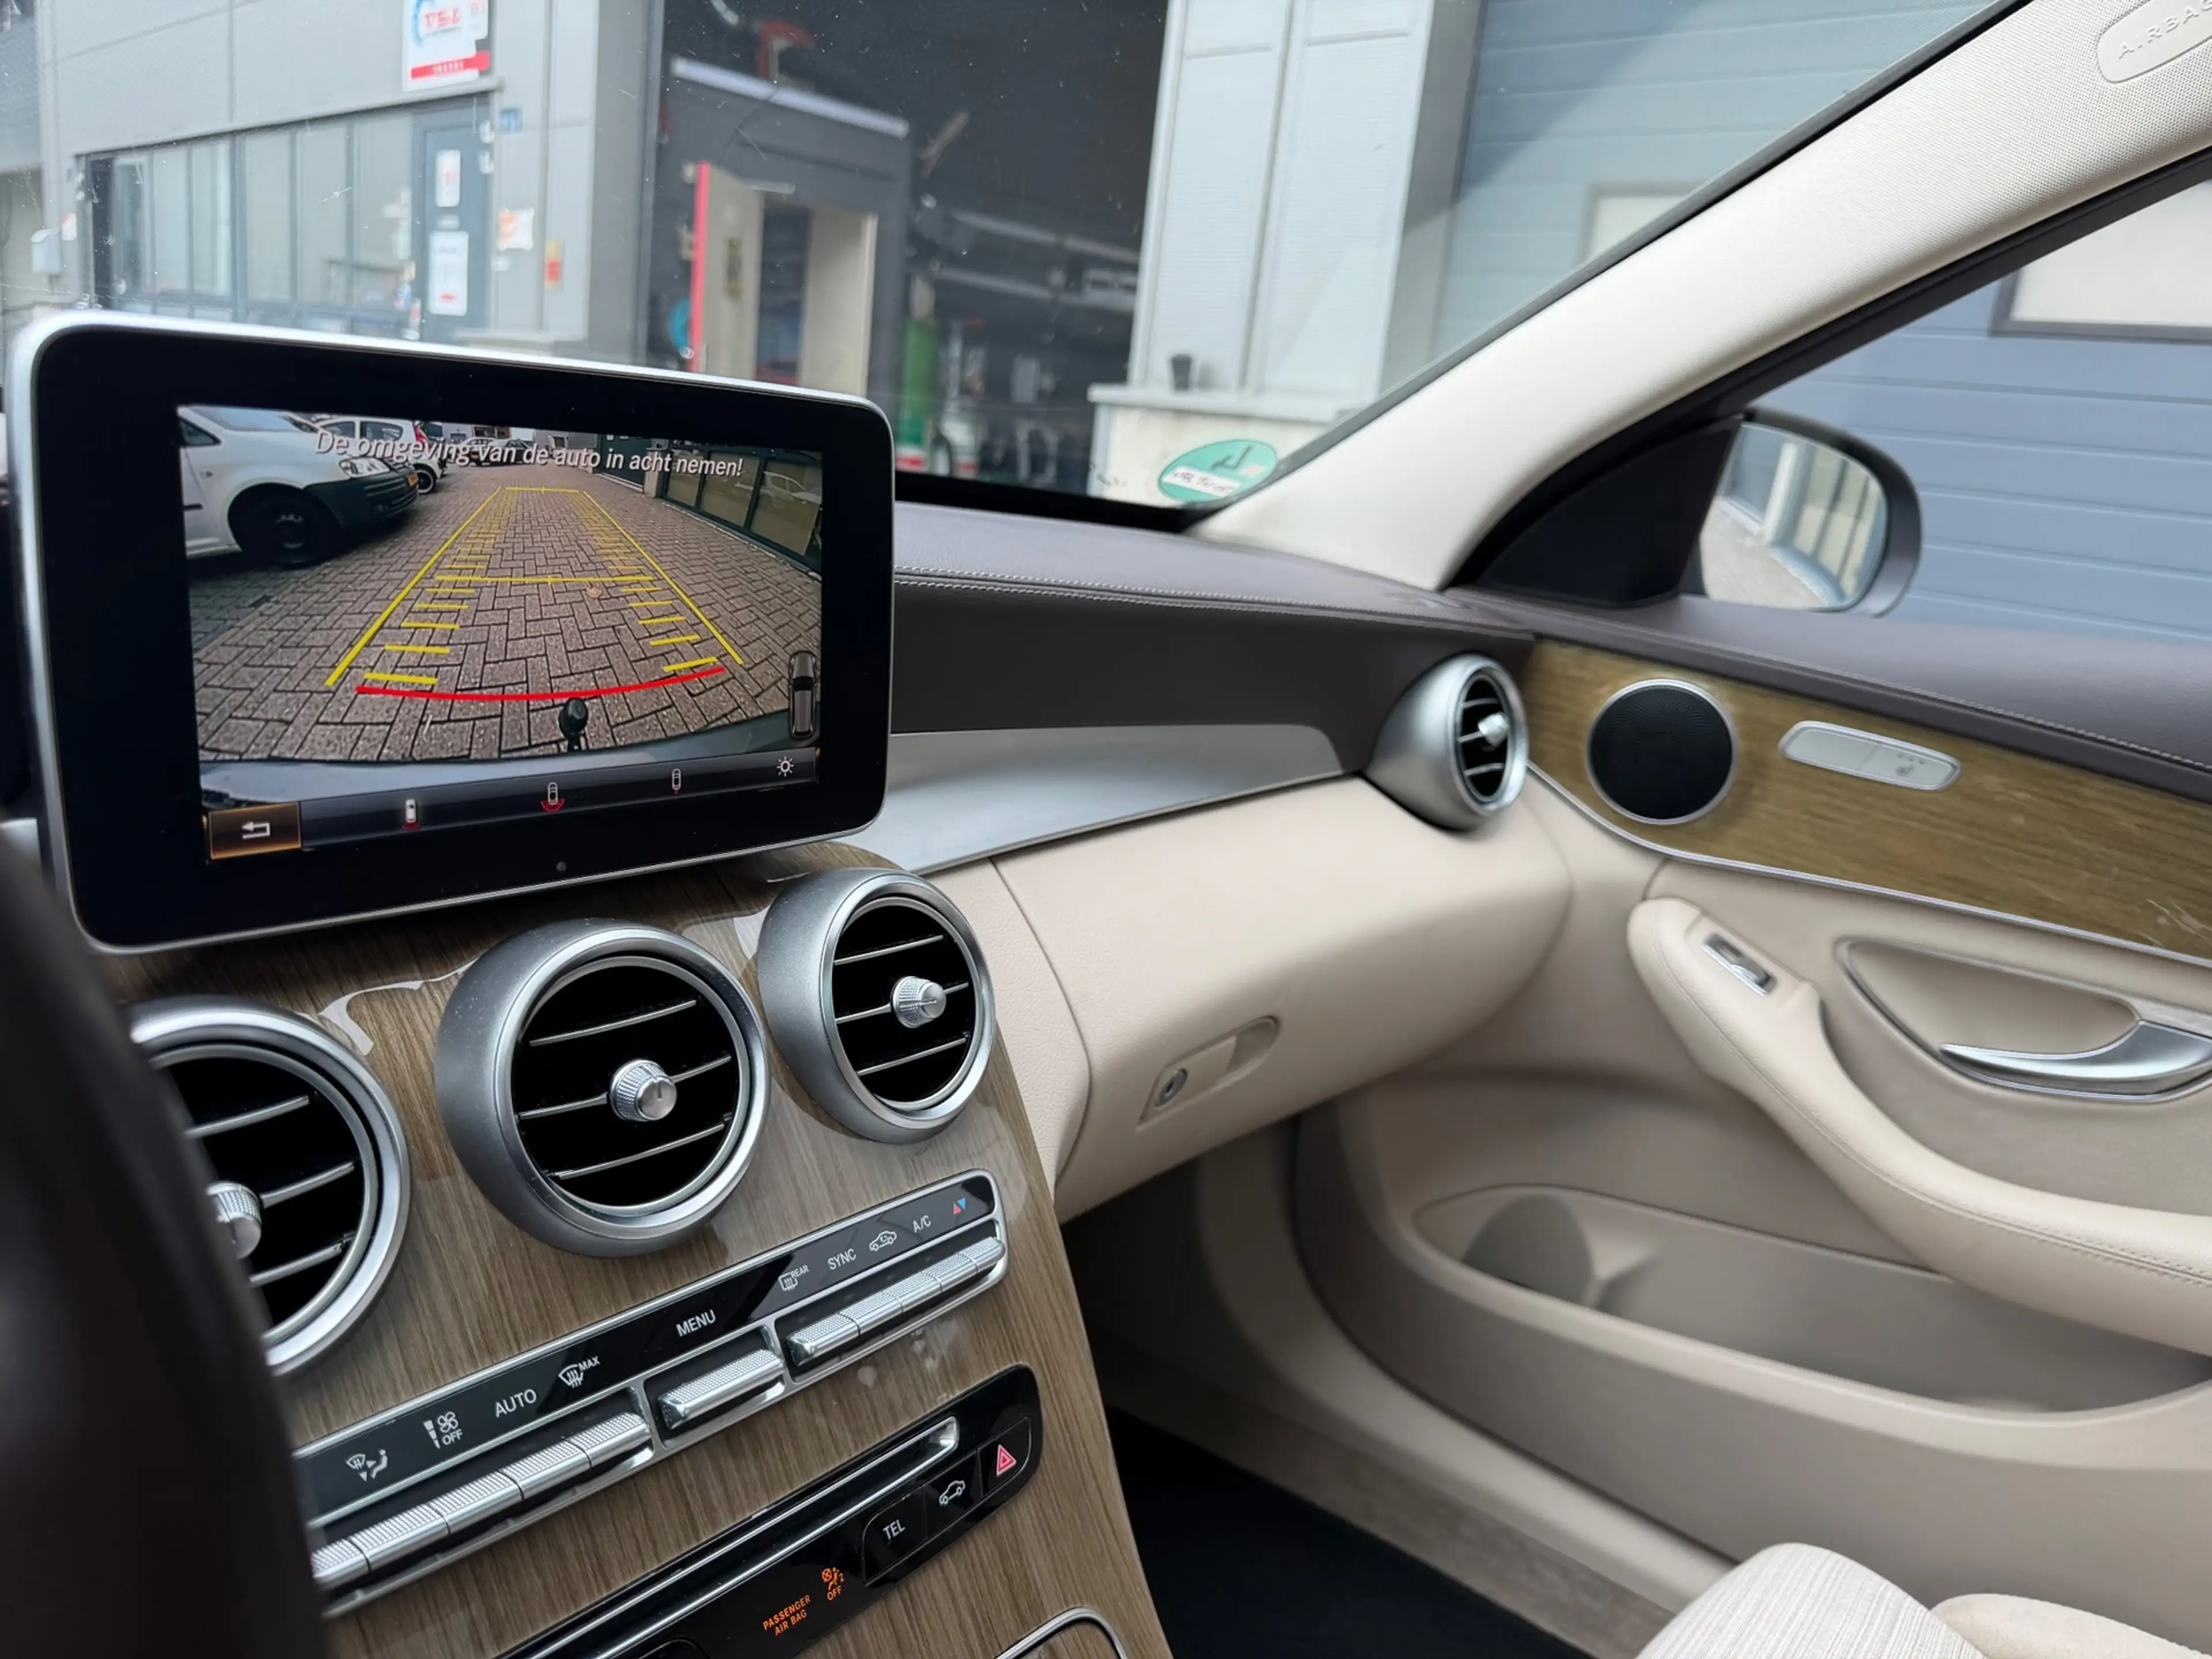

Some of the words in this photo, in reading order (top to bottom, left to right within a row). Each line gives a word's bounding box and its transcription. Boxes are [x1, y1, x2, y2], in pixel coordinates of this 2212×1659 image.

[315, 432, 347, 453] De
[358, 437, 470, 465] omgeving
[479, 446, 516, 463] van
[522, 444, 549, 465] de
[555, 448, 600, 469] auto
[605, 449, 624, 469] in
[629, 451, 671, 472] acht
[675, 457, 743, 476] nemen!
[912, 1214, 931, 1233] A/C
[827, 1248, 857, 1271] SYNC
[791, 1265, 809, 1278] REAR
[675, 1309, 717, 1338] MENU
[578, 1356, 600, 1372] MAX
[495, 1389, 537, 1417] AUTO
[442, 1429, 462, 1445] OFF
[883, 1519, 906, 1541] TEL
[827, 1585, 842, 1601] OFF
[763, 1594, 811, 1631] PASSENGER
[775, 1620, 789, 1635] AIR
[792, 1609, 807, 1625] BAG
